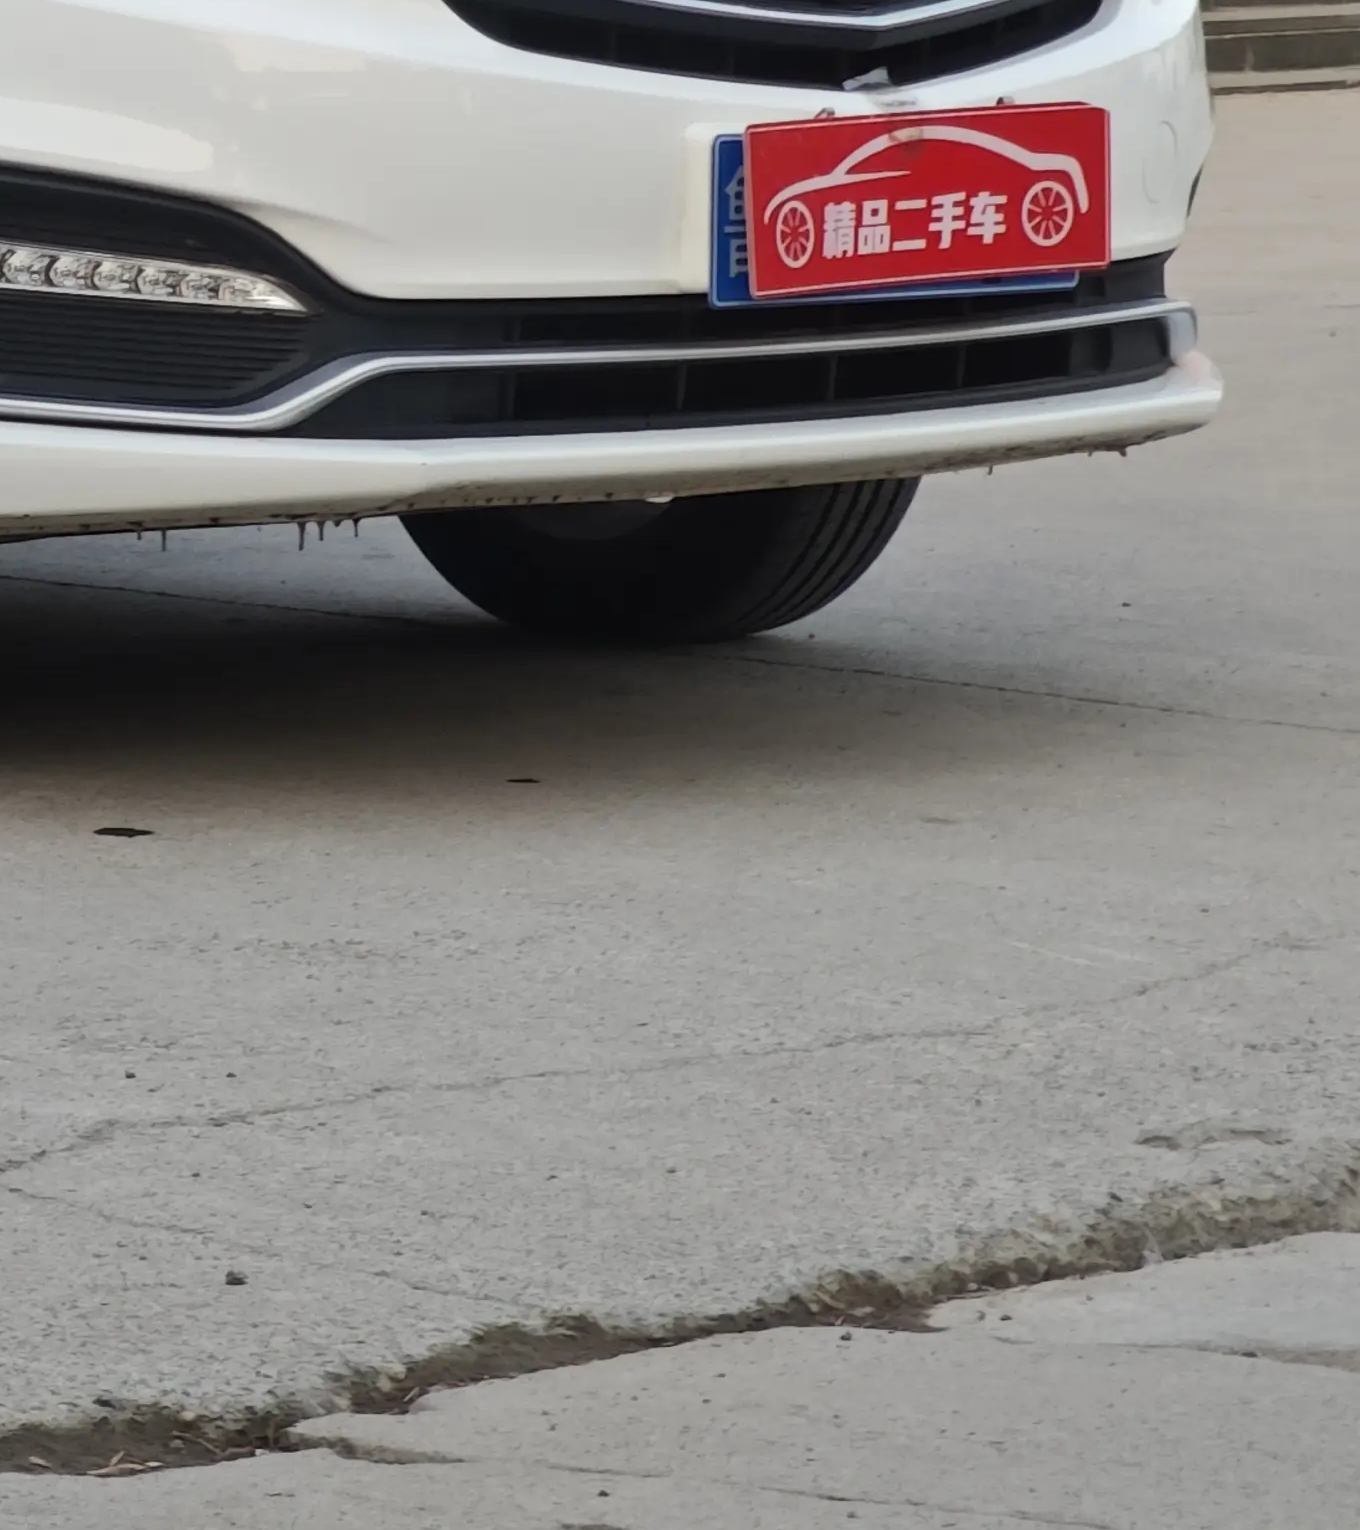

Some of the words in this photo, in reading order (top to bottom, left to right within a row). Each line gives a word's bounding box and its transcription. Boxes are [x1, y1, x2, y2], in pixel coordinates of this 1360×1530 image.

[822, 191, 1008, 259] 精品二手车
